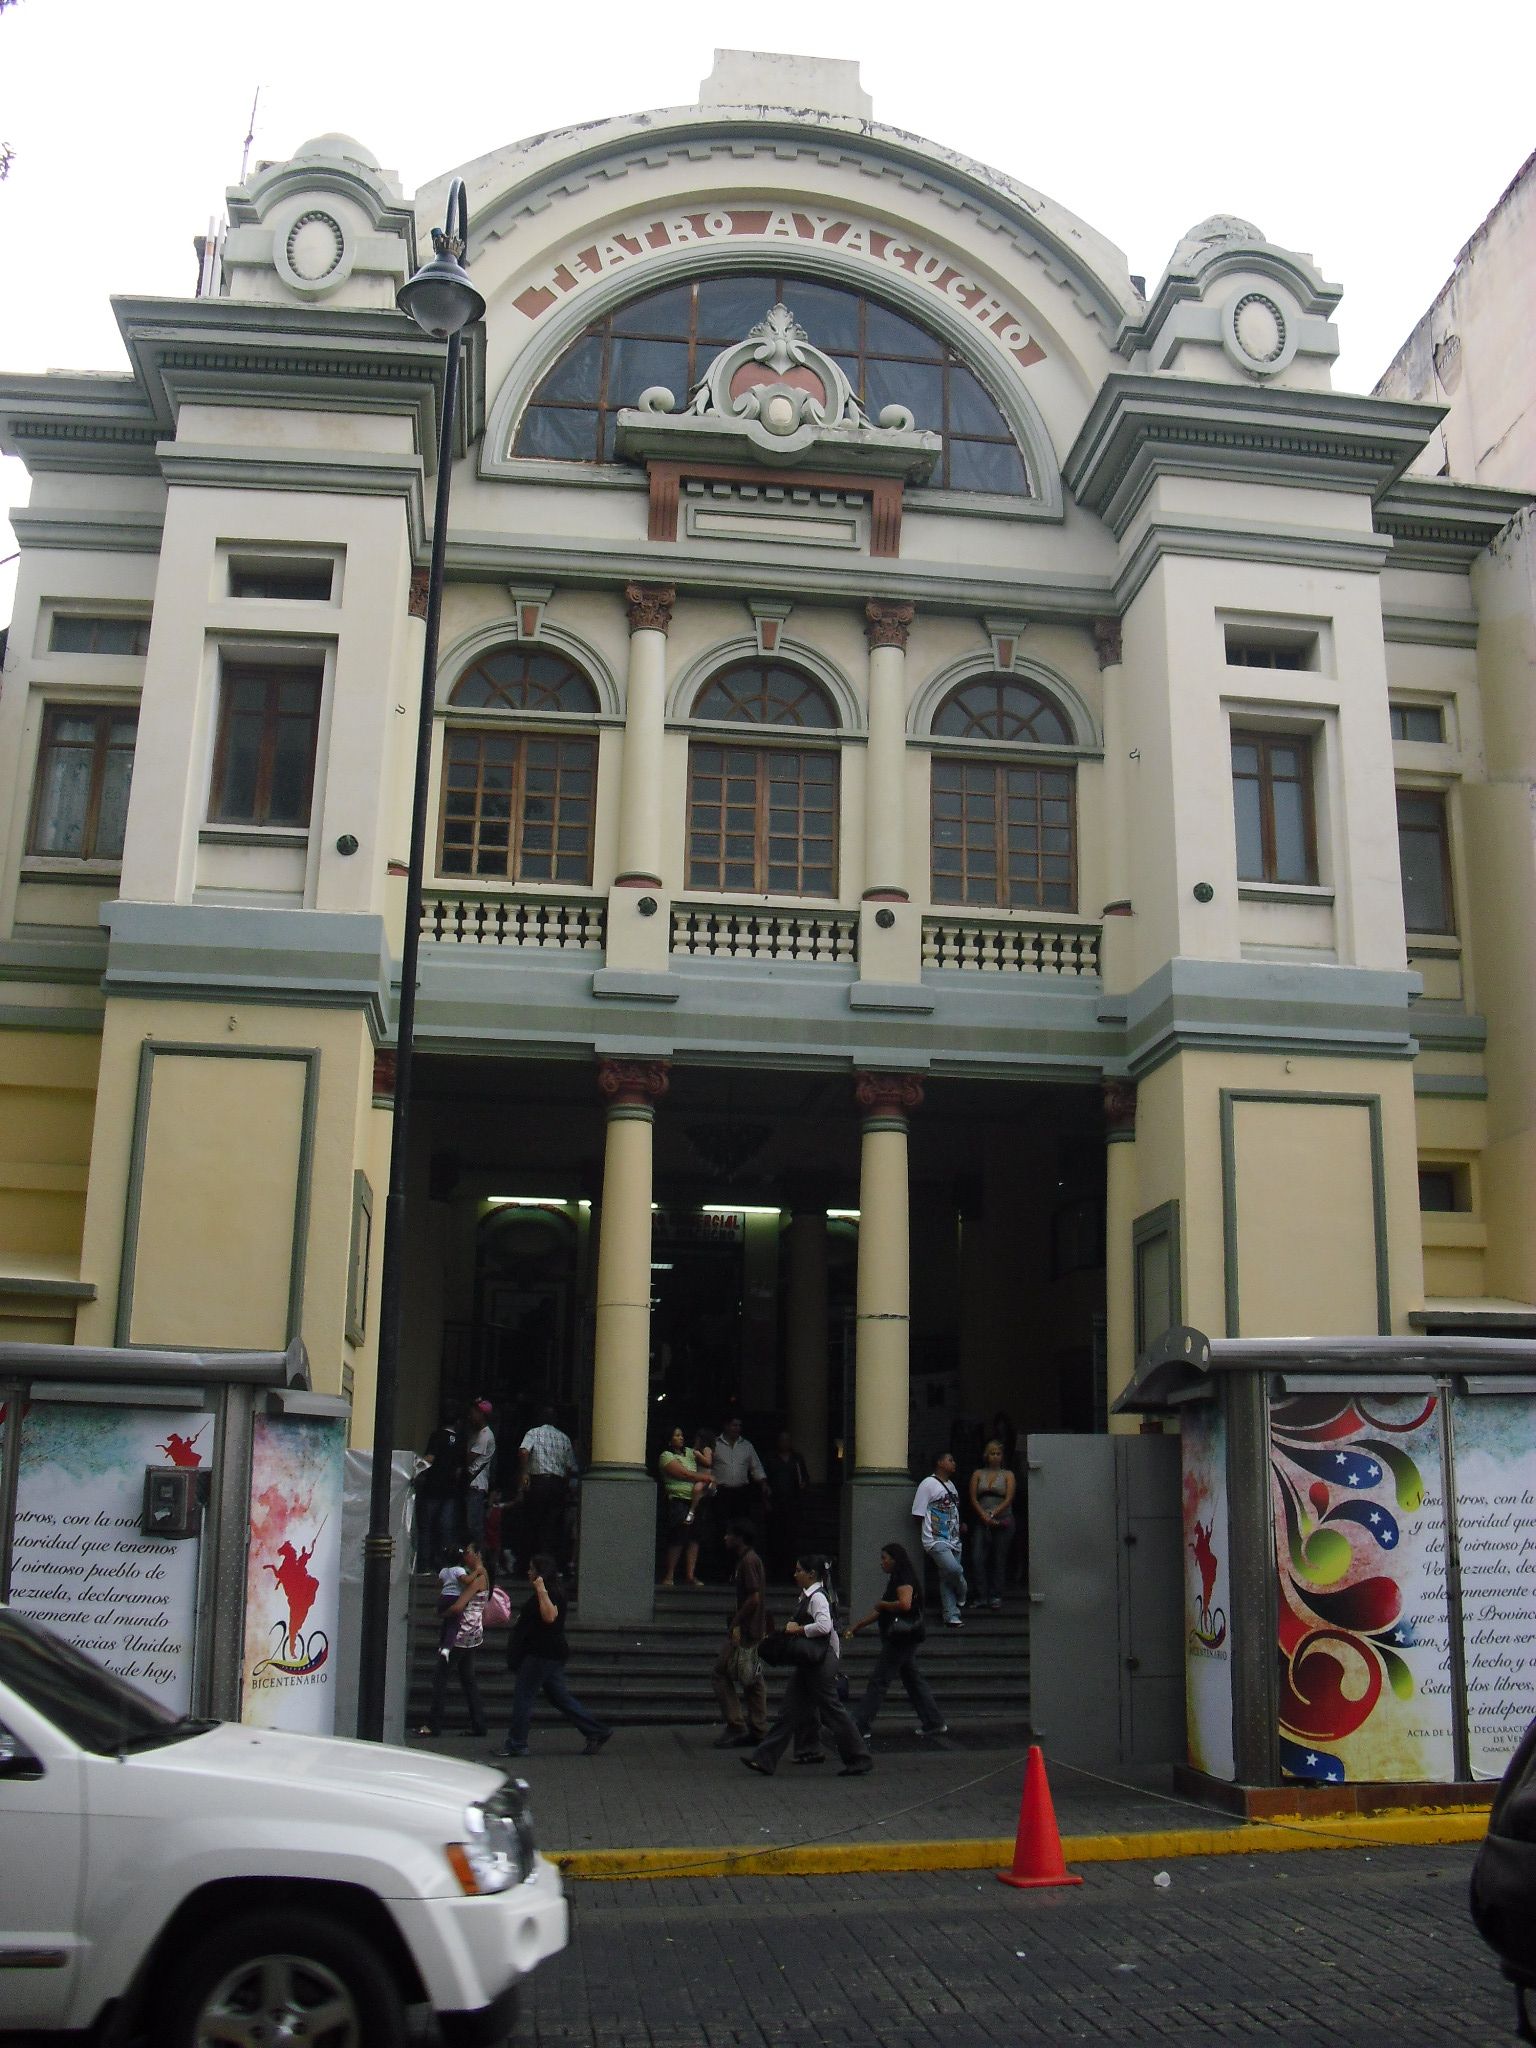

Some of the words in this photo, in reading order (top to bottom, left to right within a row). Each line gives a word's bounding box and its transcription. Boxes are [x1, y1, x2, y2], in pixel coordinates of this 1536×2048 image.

[533, 209, 735, 298] TEATRO
[764, 210, 1031, 352] AYACUCHO
[1493, 1495, 1517, 1505] con
[1520, 1489, 1534, 1505] la
[62, 1513, 89, 1526] con
[94, 1510, 110, 1527] la
[1408, 1521, 1423, 1536] y
[81, 1542, 110, 1557] que
[113, 1541, 178, 1555] tenemos
[1464, 1539, 1519, 1551] virtuoso
[21, 1560, 85, 1576] virtuoso
[83, 1562, 141, 1582] pueblo
[145, 1563, 167, 1580] de
[77, 1585, 171, 1606] declaramos
[94, 1608, 114, 1625] al
[112, 1611, 170, 1628] mundo
[1410, 1614, 1435, 1629] que
[123, 1635, 182, 1655] Unidas
[1471, 1629, 1511, 1645] deben
[1472, 1652, 1512, 1668] hecho
[1509, 1658, 1525, 1674] y
[142, 1660, 178, 1685] hoy,
[251, 1674, 329, 1690] BICENTENARIO
[1493, 1675, 1535, 1693] libres,
